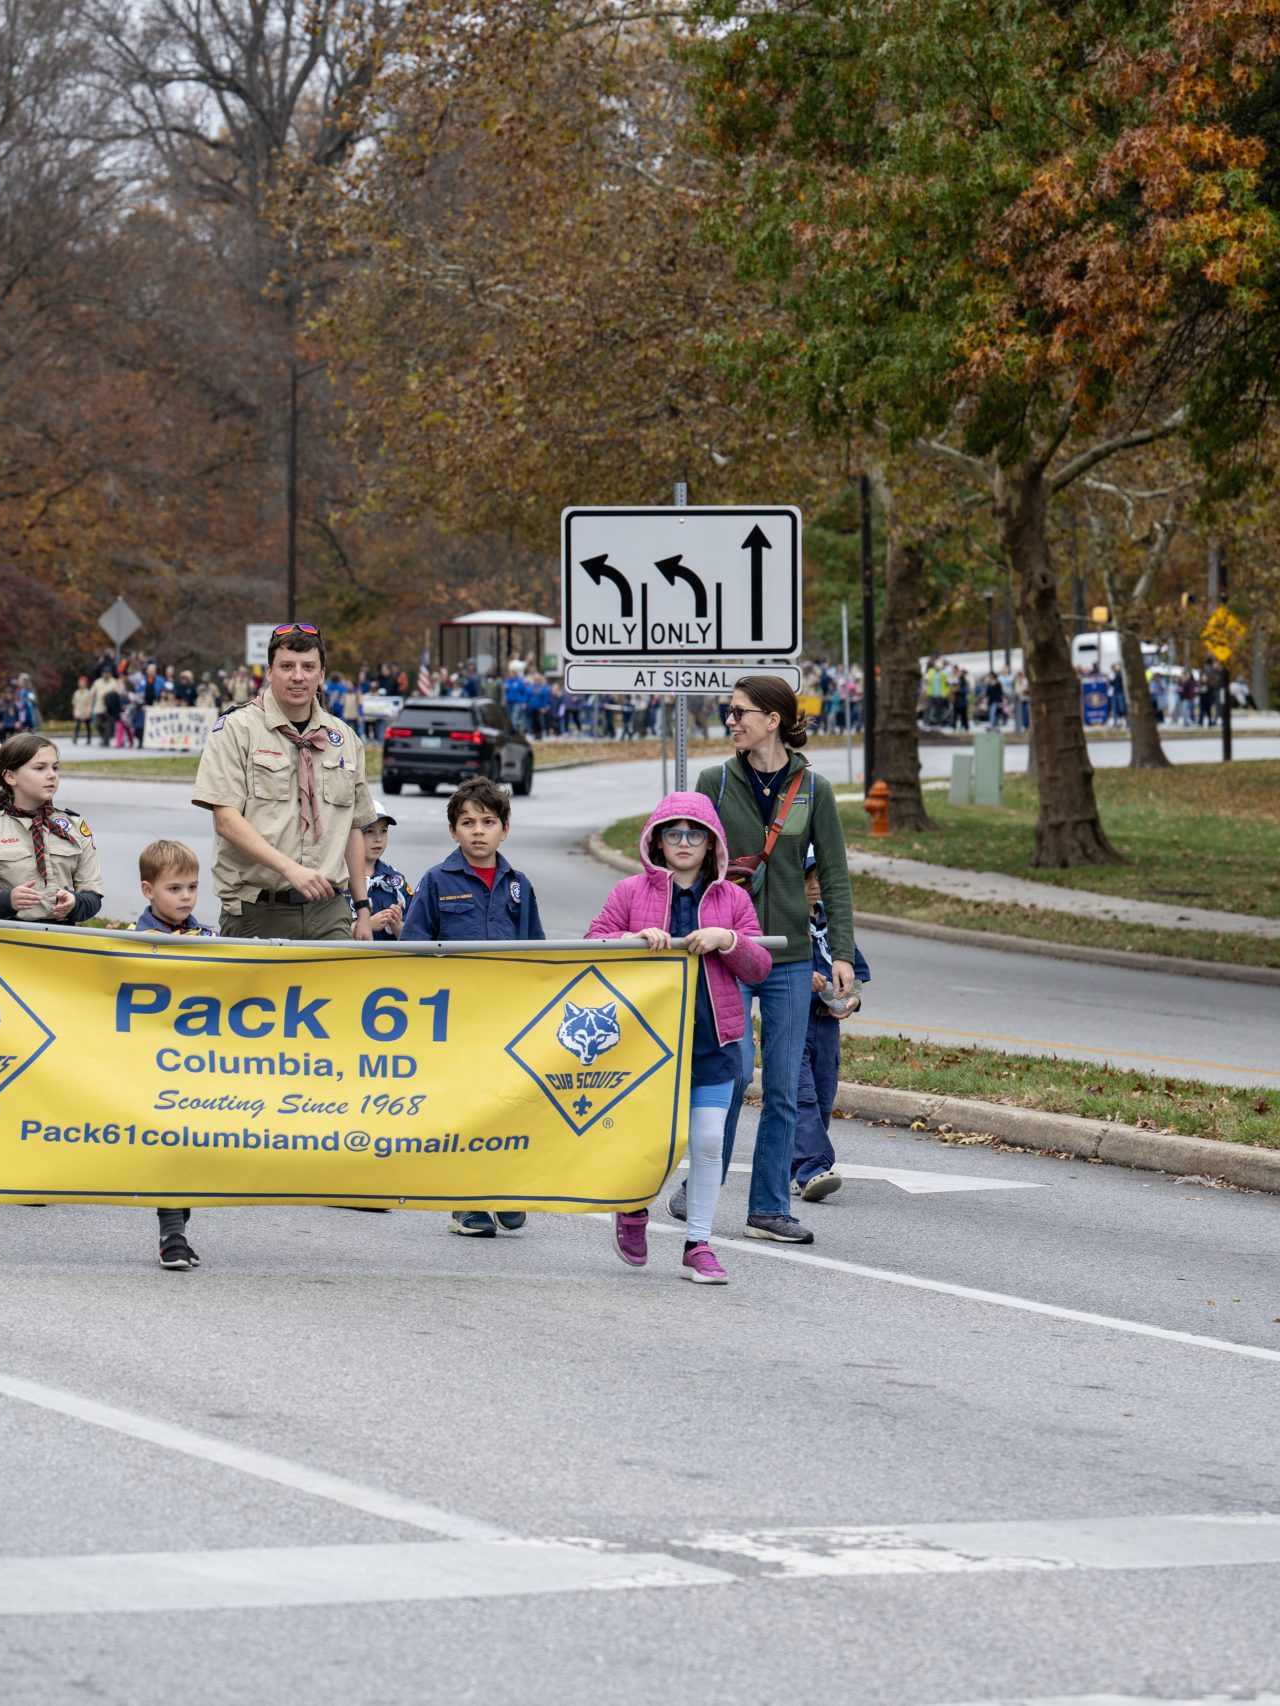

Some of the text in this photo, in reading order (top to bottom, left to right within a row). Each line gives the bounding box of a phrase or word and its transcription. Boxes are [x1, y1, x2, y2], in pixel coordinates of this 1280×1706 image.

[575, 622, 637, 645] ONLY
[650, 622, 713, 645] ONLY
[634, 670, 732, 688] AT SIGNAL
[115, 982, 451, 1042] Pack 61
[155, 1047, 418, 1082] Columbia, MD
[544, 1071, 632, 1090] CUB SCOUTS
[153, 1089, 427, 1119] Scouting Since 1968
[20, 1119, 530, 1158] Pack61columbiamd@gmail.com
